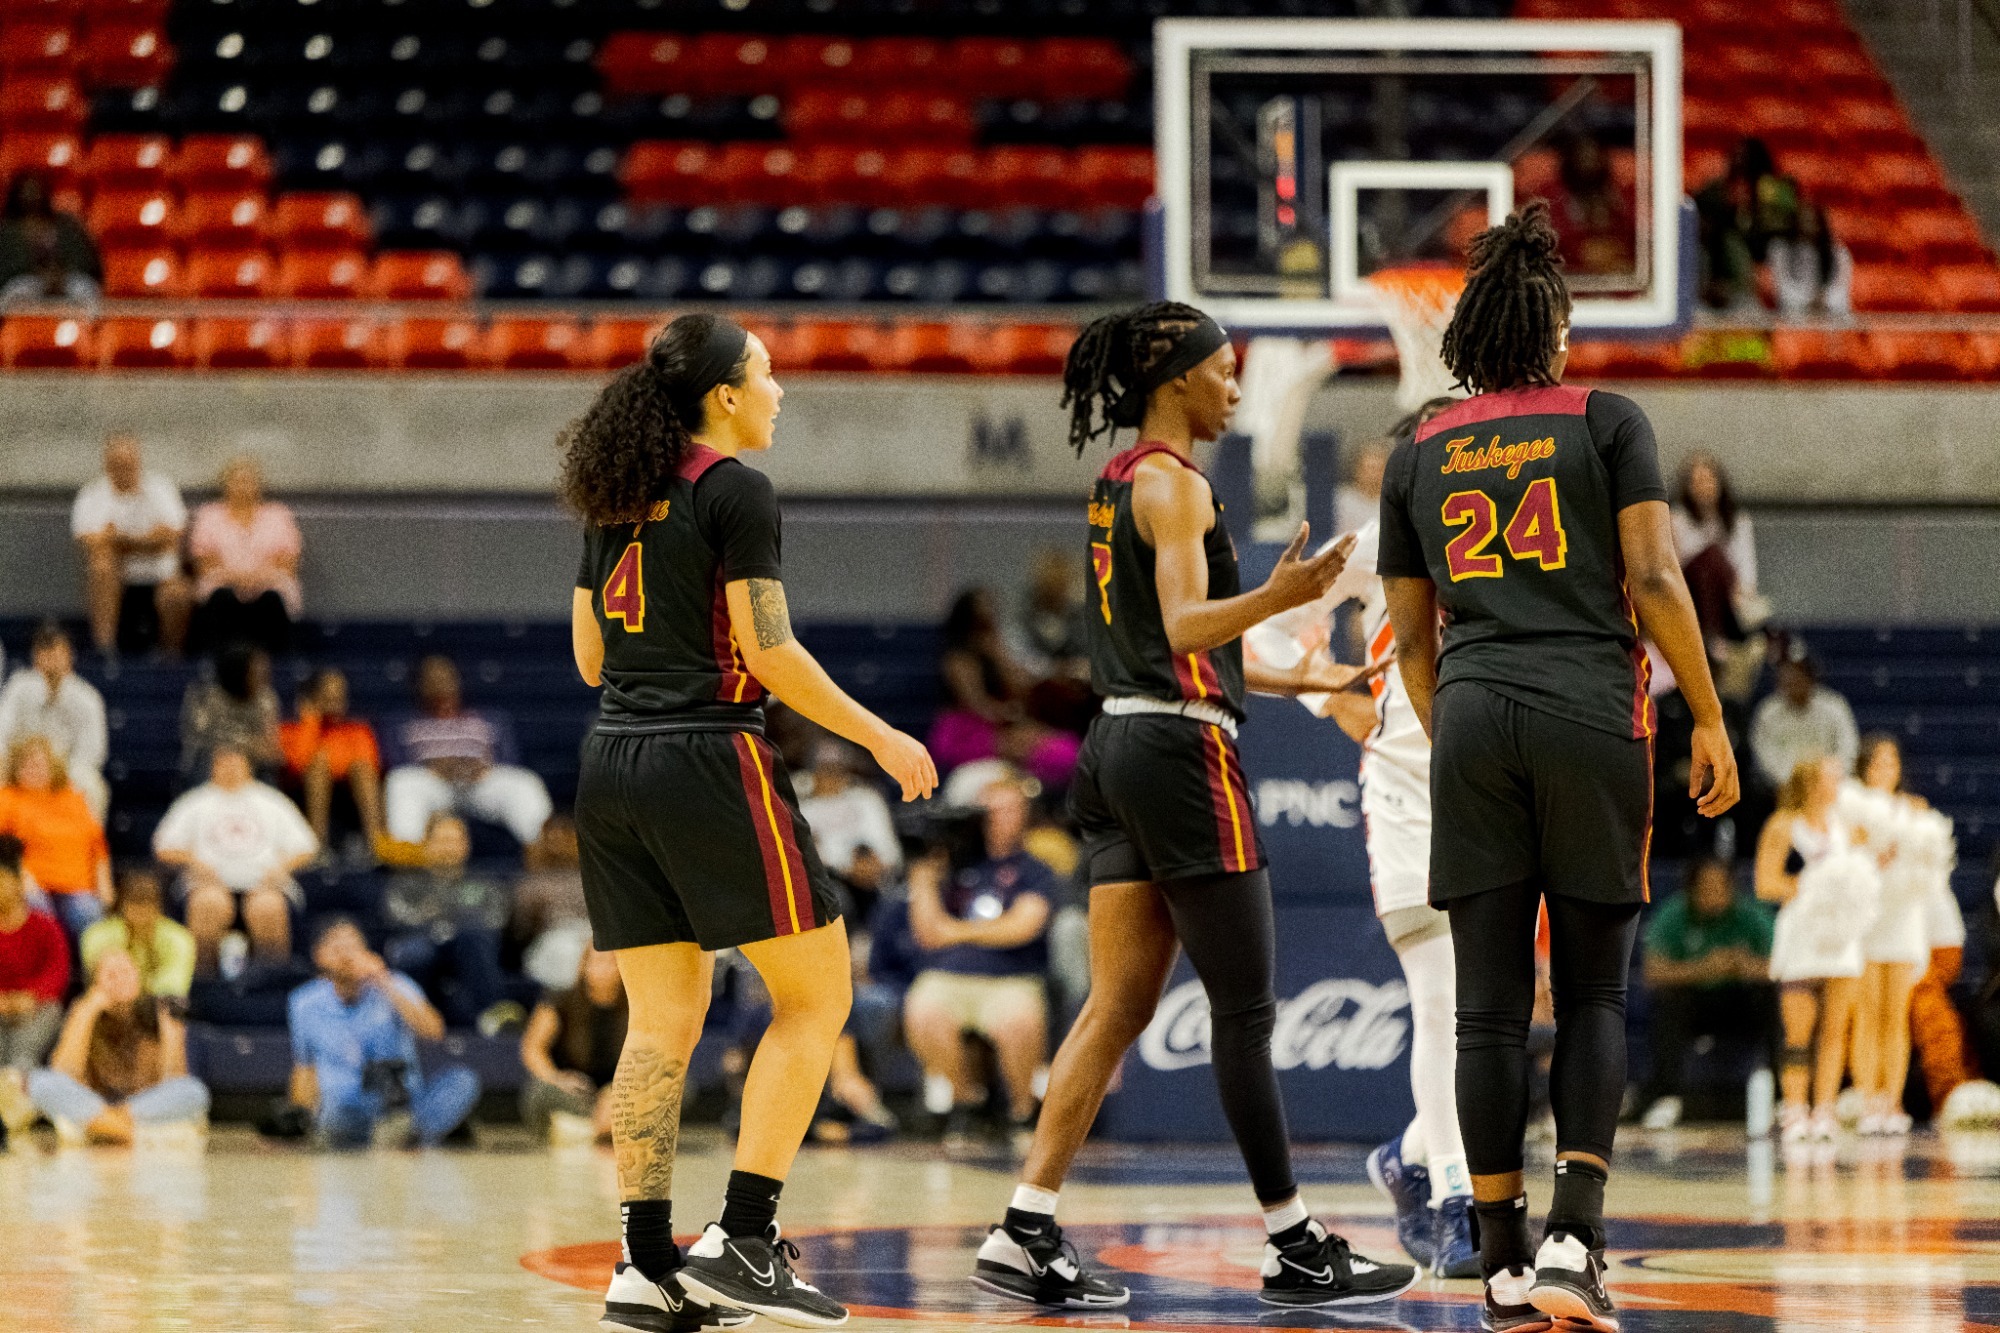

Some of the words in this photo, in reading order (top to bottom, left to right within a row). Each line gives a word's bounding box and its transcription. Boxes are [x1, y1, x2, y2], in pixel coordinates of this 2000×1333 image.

[1441, 435, 1556, 479] Tuskegee
[1441, 477, 1567, 583] 24
[603, 542, 645, 632] 4
[1259, 779, 1359, 828] PNC
